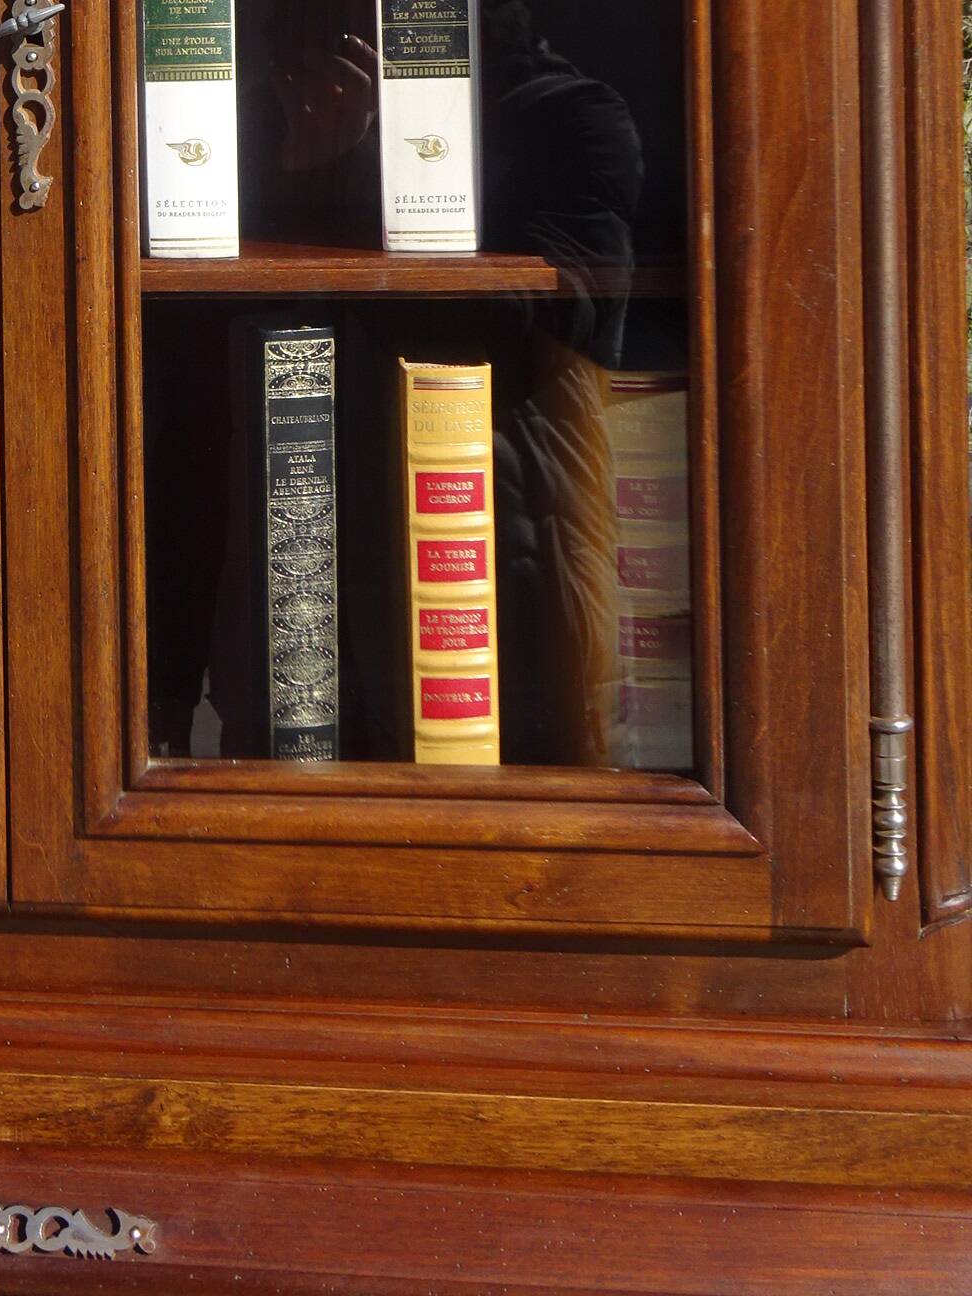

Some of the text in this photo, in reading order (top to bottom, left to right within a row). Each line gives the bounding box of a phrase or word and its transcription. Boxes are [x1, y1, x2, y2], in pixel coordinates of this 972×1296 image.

[412, 1, 437, 9] AVEC
[169, 6, 208, 15] DE NUIT
[393, 11, 457, 20] LES ANIMAUX
[162, 36, 216, 46] UNE ÉTOILE
[400, 36, 412, 44] LA
[156, 47, 223, 56] SUR ANTIOCHE
[403, 45, 448, 54] DU JUSTE
[156, 200, 228, 208] SÉLECTION
[395, 195, 467, 204] SÉLECTION
[271, 413, 330, 425] CHATEAUBRIAND
[414, 420, 434, 433] DU
[287, 454, 316, 464] ATALA
[290, 464, 314, 475] RENÉ
[275, 475, 328, 487] LE DERNIER
[425, 481, 475, 491] L'AFFAIRE
[272, 484, 332, 496] ABENCÉRAGE
[427, 549, 477, 559] LA TERRE
[430, 562, 476, 572] SOUMISE
[427, 615, 439, 624] LE
[420, 625, 434, 635] DU
[441, 637, 468, 648] JOUR
